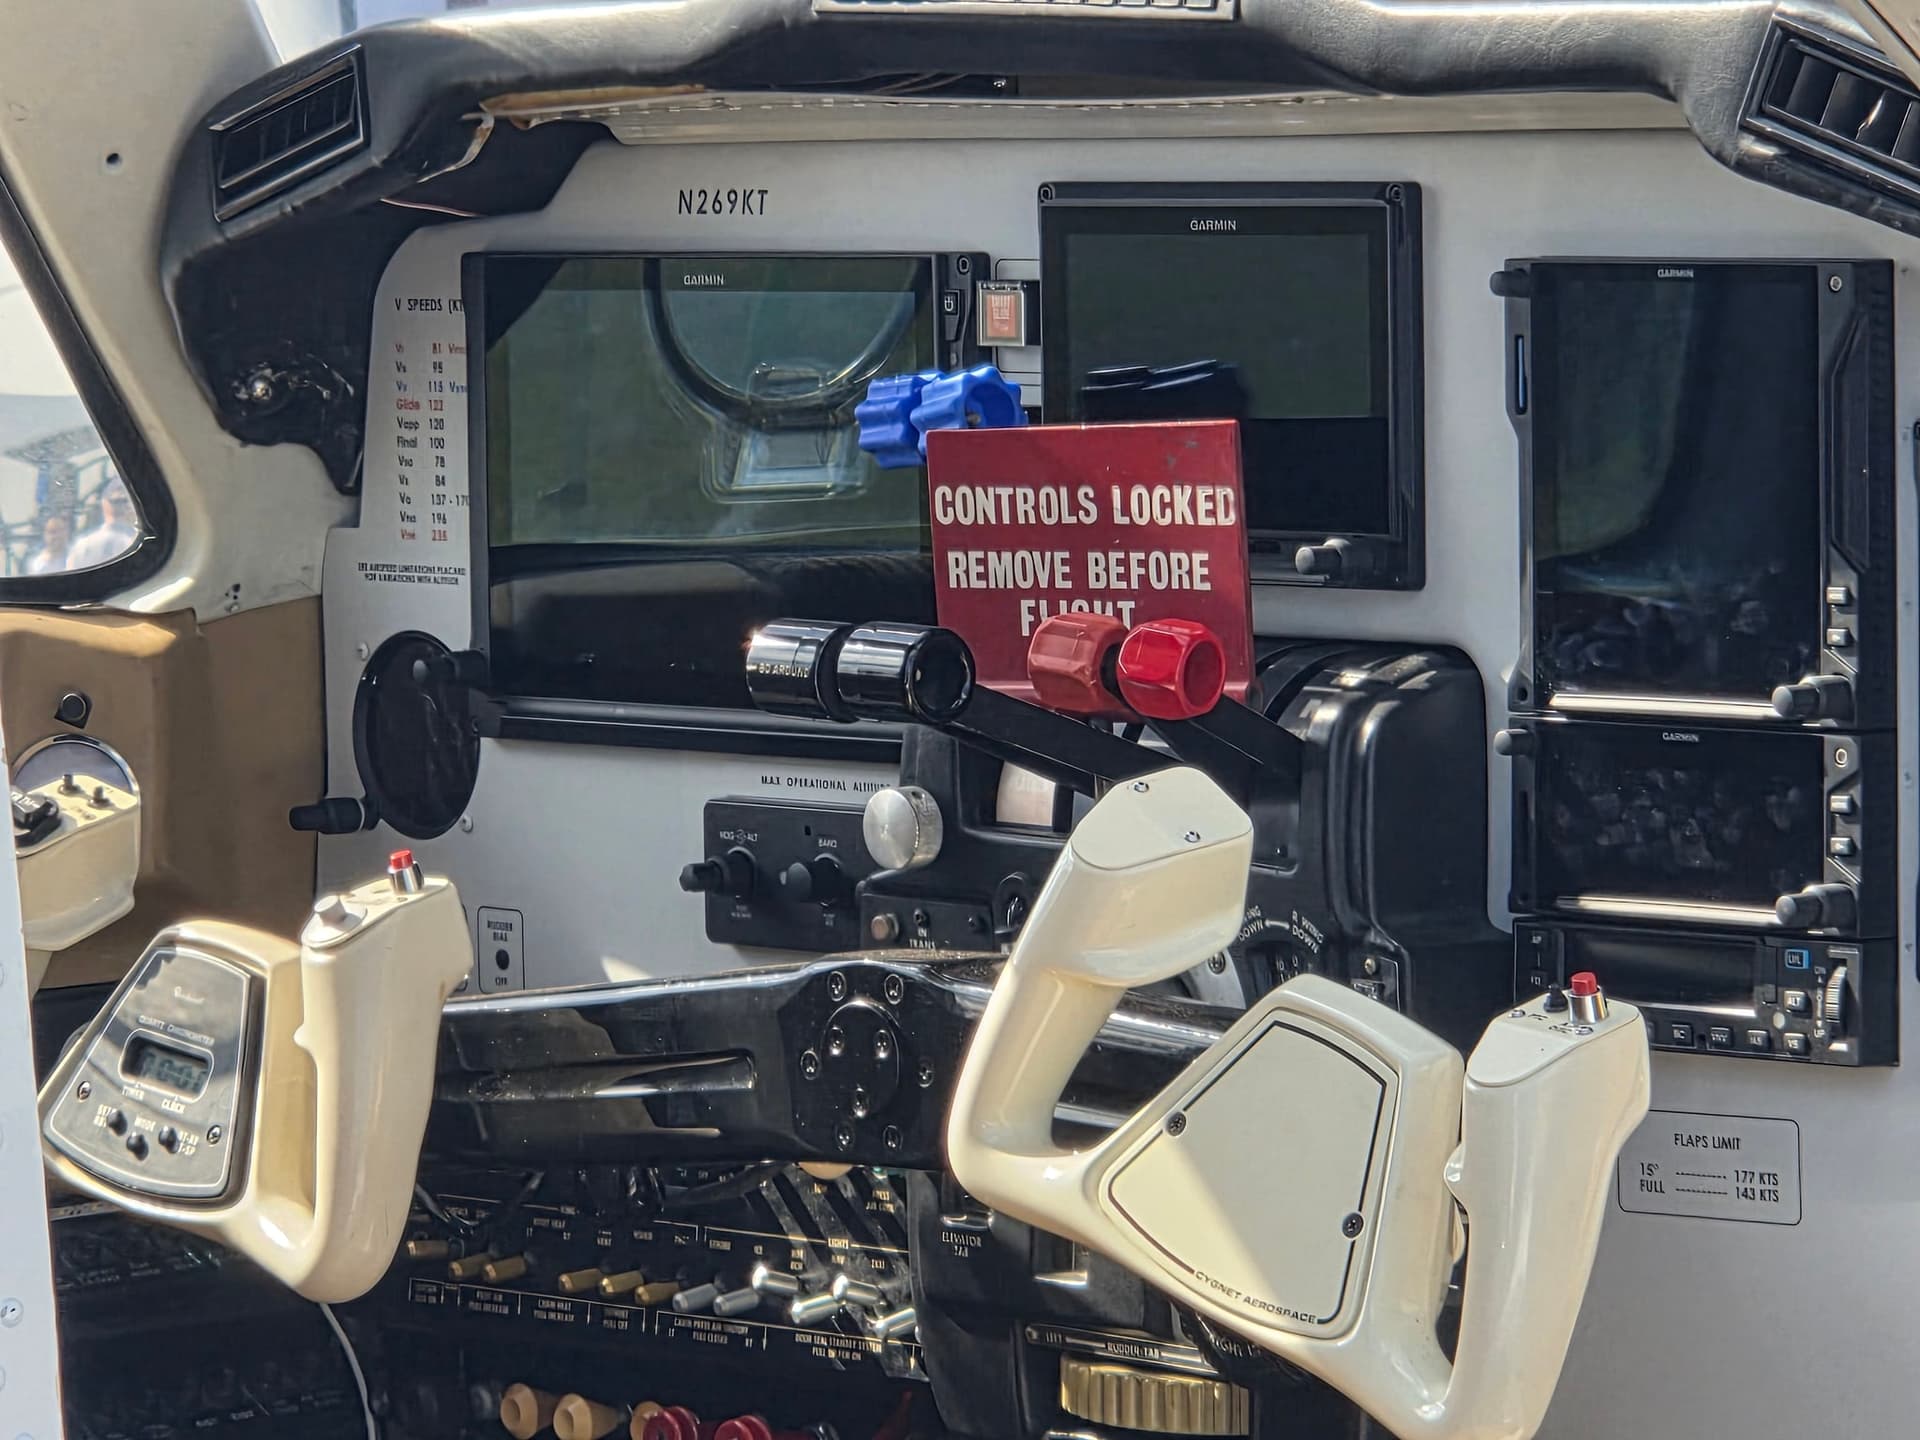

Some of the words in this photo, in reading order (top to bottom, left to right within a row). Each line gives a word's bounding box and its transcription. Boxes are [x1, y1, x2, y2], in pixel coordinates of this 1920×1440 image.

[679, 189, 768, 215] N269KT
[1190, 219, 1237, 231] GARMIN
[683, 275, 724, 286] GARMIN
[395, 298, 401, 311] V
[407, 299, 443, 311] SPEEDS
[429, 418, 444, 430] 120
[397, 437, 417, 448] Final
[430, 437, 444, 449] 100
[431, 494, 446, 506] 137
[934, 485, 1098, 525] CONTROLS
[1111, 485, 1237, 526] LOCKED
[947, 550, 1073, 590] REMOVE
[1087, 551, 1212, 591] BEFORE
[772, 663, 810, 678] AROUND
[786, 777, 847, 791] OPERATIONAL
[1239, 920, 1264, 942] DOWN
[1292, 925, 1319, 954] DOWN
[1674, 1133, 1709, 1149] FLAPS
[1712, 1136, 1741, 1150] LIMIT
[1734, 1169, 1755, 1184] 177
[1759, 1172, 1779, 1186] KTS
[1640, 1179, 1665, 1194] FULL
[1735, 1186, 1756, 1201] 143
[1760, 1188, 1780, 1203] KTS
[1194, 1270, 1242, 1299] CYGNET
[1242, 1295, 1318, 1325] AEROSPACE
